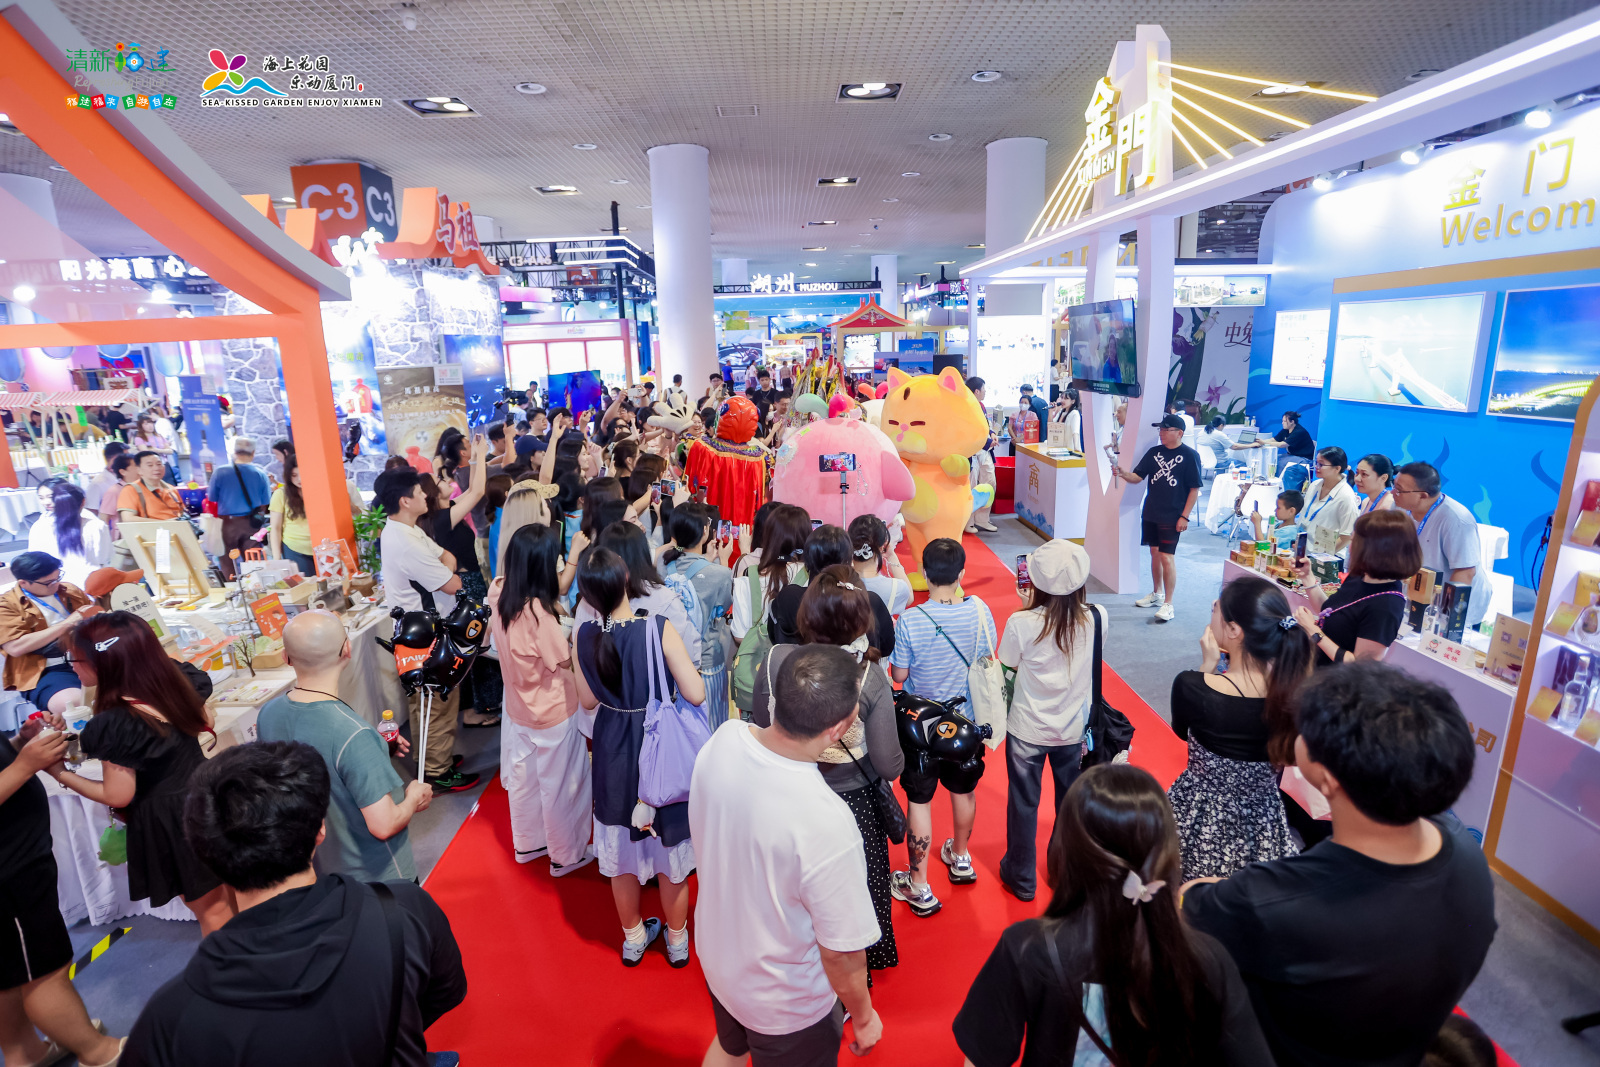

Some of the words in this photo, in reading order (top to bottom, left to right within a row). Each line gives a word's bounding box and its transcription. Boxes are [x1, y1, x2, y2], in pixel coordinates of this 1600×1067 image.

[301, 183, 359, 221] C3
[366, 186, 395, 227] C3
[1441, 197, 1596, 246] Welcom
[436, 192, 480, 253] 马祖
[751, 272, 796, 294] 湖州
[1468, 721, 1497, 753] 司
